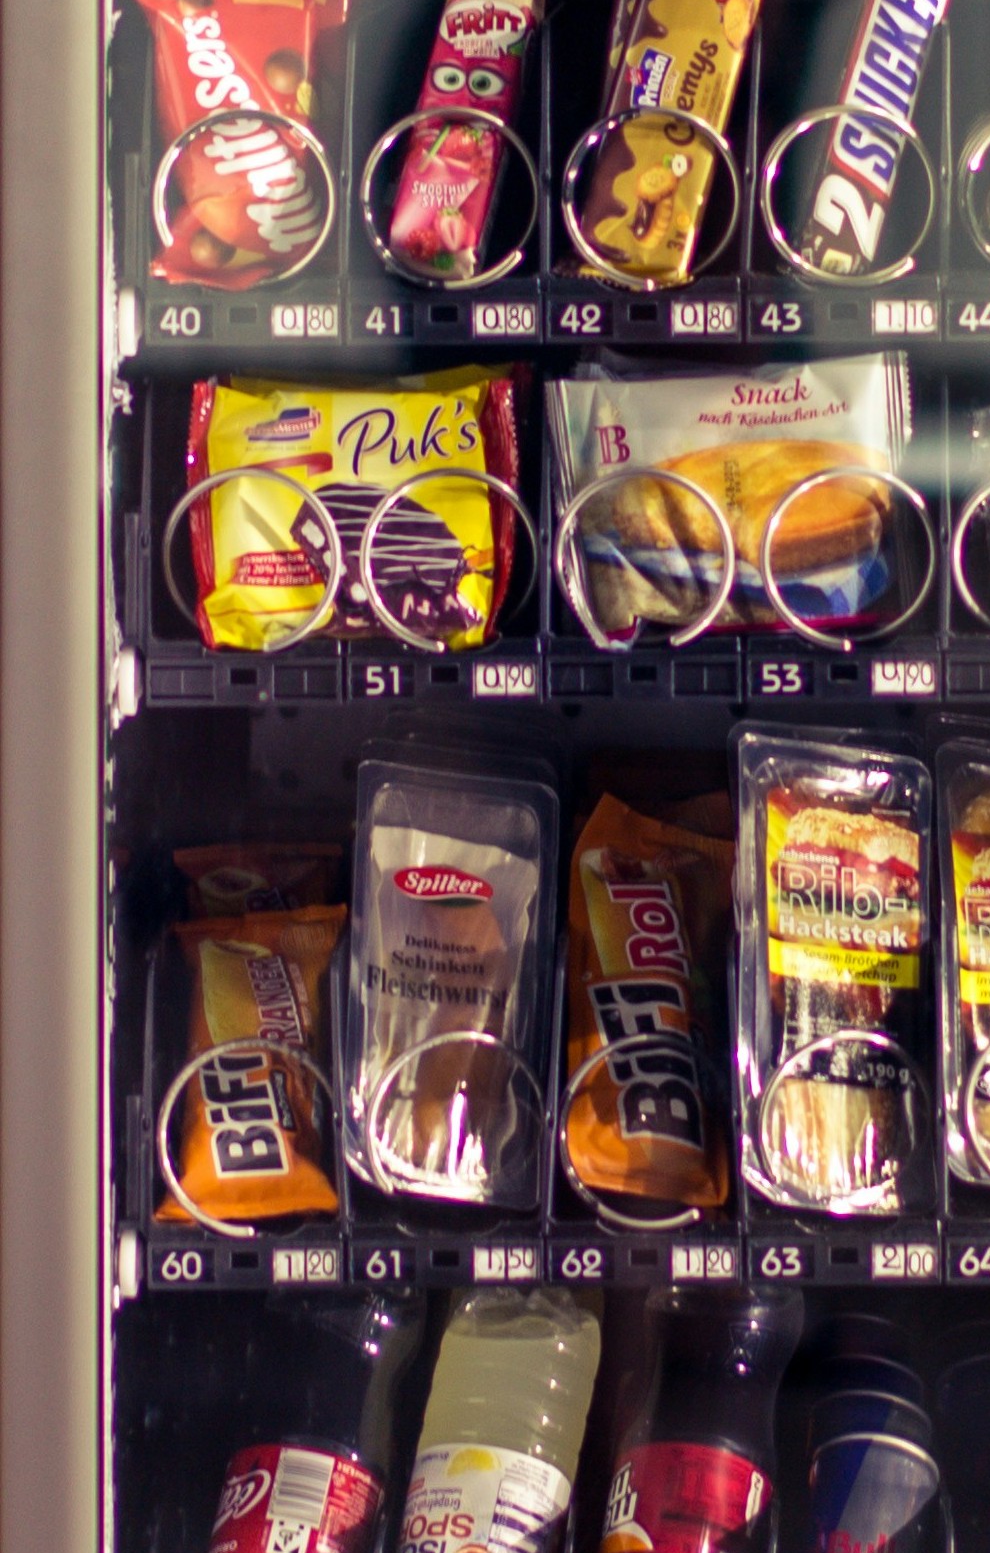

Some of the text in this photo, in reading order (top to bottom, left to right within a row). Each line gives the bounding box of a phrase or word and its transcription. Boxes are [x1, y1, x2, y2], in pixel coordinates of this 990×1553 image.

[662, 37, 719, 147] Cemys
[813, 173, 886, 263] 2
[160, 306, 201, 336] 40
[365, 306, 400, 335] 41
[559, 304, 602, 334] 42
[760, 303, 802, 333] 43
[730, 377, 812, 407] Snack
[698, 399, 849, 429] nach Käsekuchen Art
[337, 400, 479, 478] Puk's
[365, 665, 401, 695] 51
[761, 663, 802, 693] 53
[404, 870, 485, 895] Spilker
[777, 860, 908, 923] Rib-
[778, 914, 908, 949] Hacksteak
[391, 949, 485, 977] Schinken
[867, 1062, 895, 1078] 190
[161, 1253, 202, 1280] 60
[366, 1253, 401, 1279] 61
[562, 1249, 602, 1276] 62
[760, 1248, 801, 1274] 63
